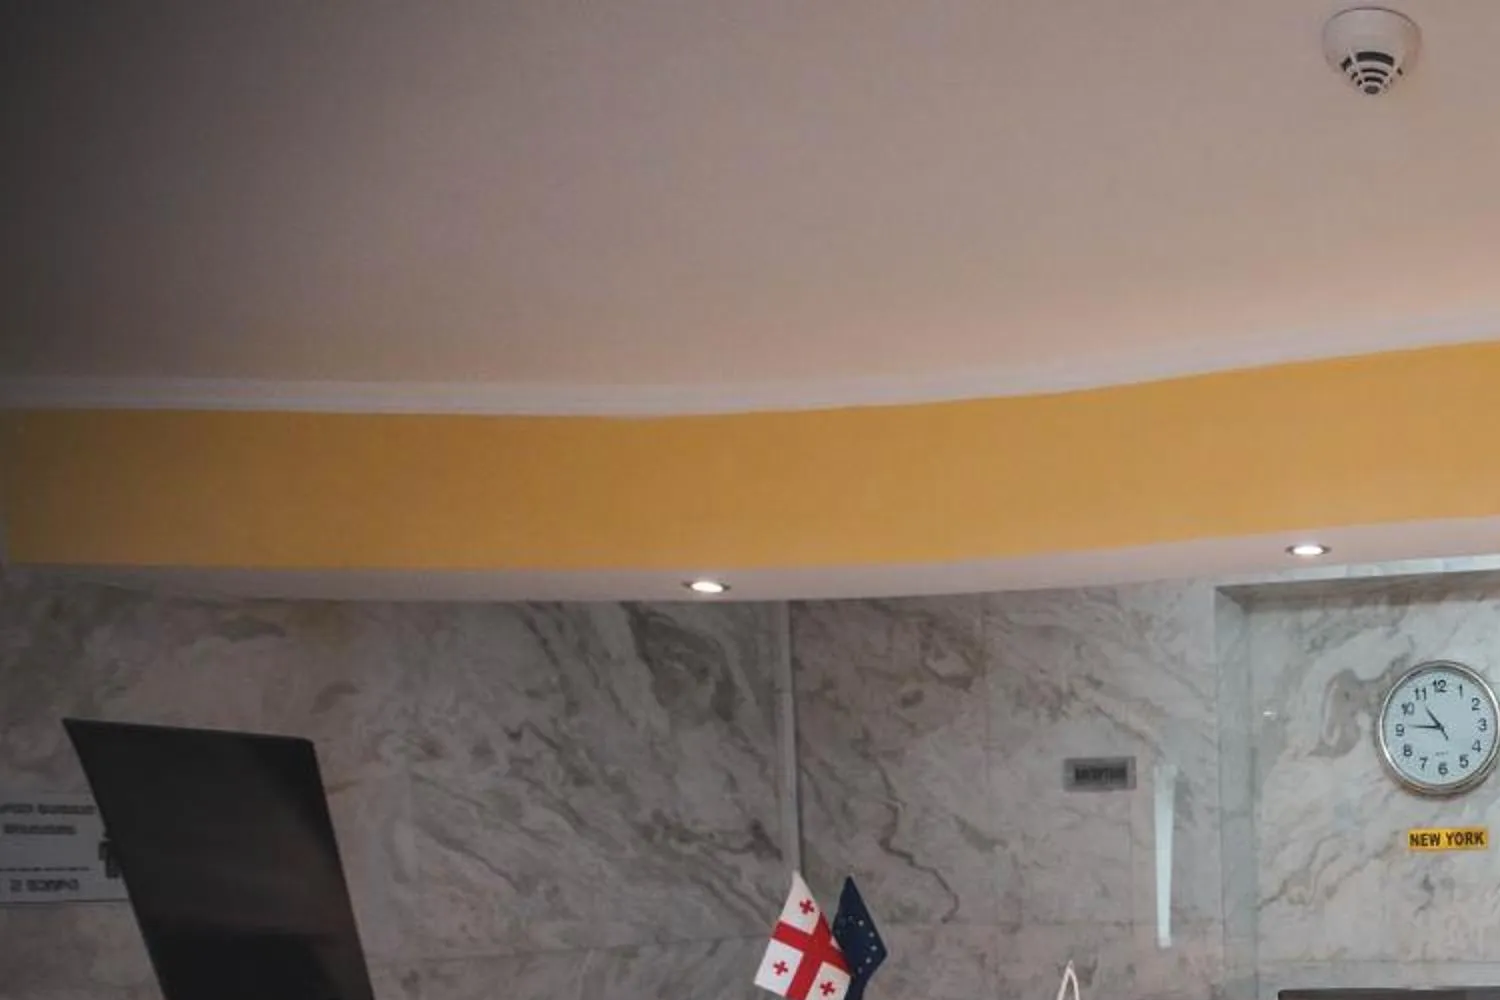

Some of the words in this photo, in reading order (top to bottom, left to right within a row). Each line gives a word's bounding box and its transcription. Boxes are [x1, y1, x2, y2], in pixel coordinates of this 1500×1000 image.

[1432, 679, 1447, 693] 12
[1414, 687, 1427, 700] 11
[1401, 701, 1415, 715] 10
[1471, 697, 1481, 711] 2
[1395, 723, 1405, 737] 9
[1477, 718, 1488, 732] 3
[1402, 743, 1413, 757] 8
[1471, 739, 1482, 752] 4
[1419, 756, 1428, 770] 7
[1459, 754, 1469, 768] 5
[1438, 762, 1448, 776] 6
[1409, 832, 1441, 847] NEW
[1446, 831, 1485, 846] YORK
